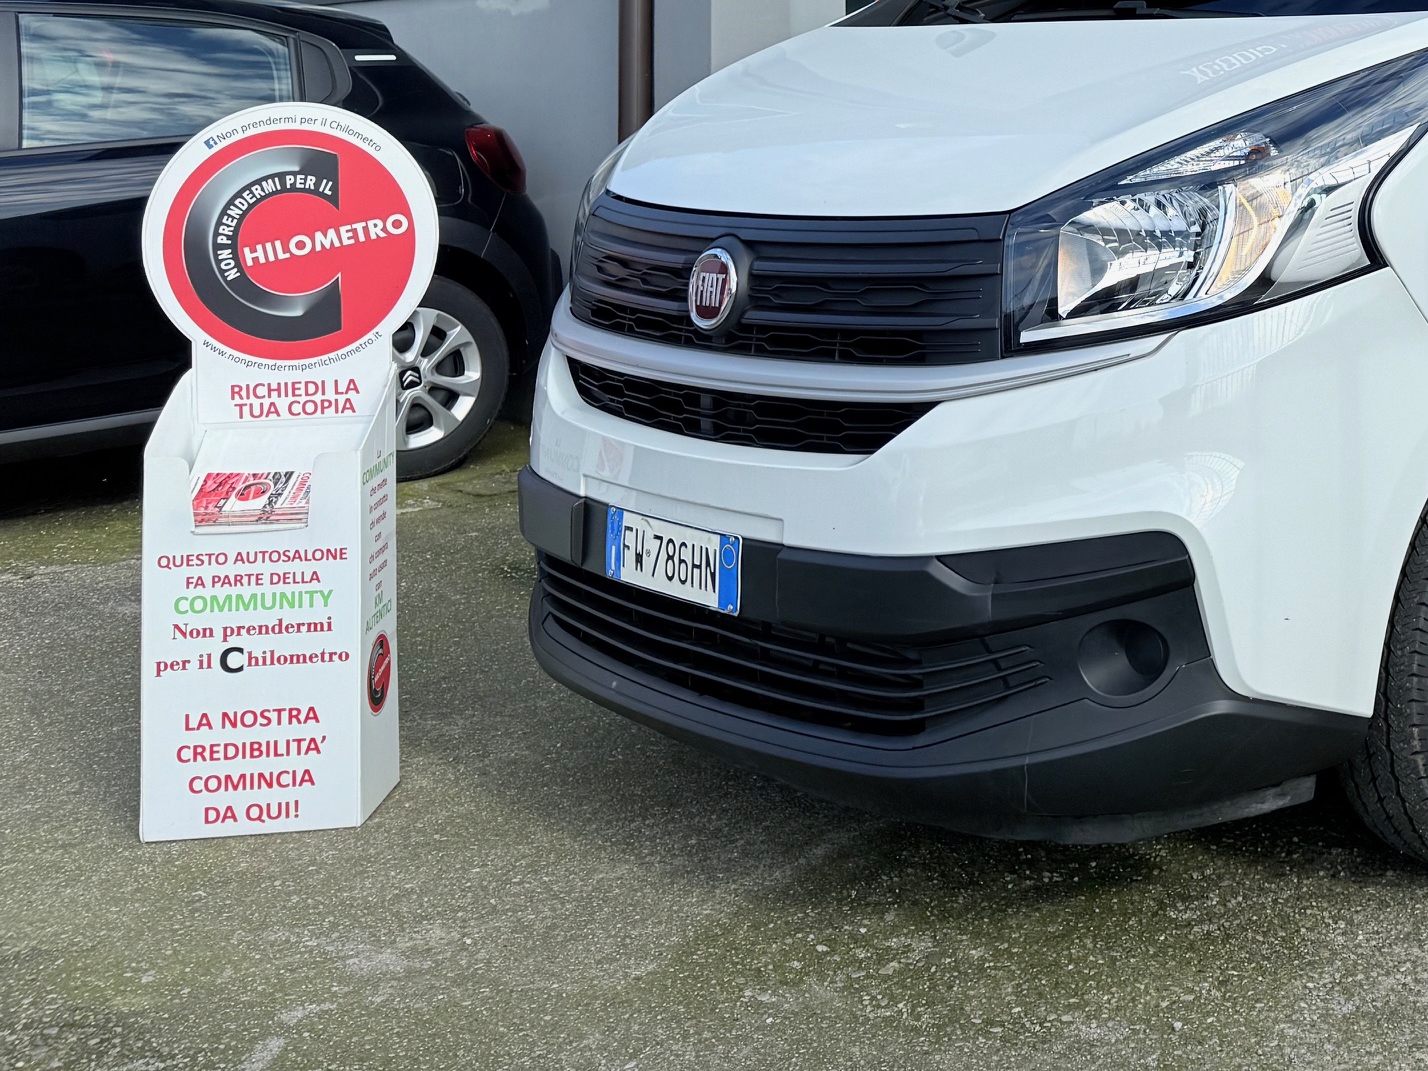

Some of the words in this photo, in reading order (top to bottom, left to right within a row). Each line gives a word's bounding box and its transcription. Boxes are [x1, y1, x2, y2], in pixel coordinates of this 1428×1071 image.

[216, 126, 239, 143] Non
[240, 115, 297, 135] prendermi
[299, 116, 318, 128] per
[320, 117, 327, 129] il
[329, 120, 382, 153] Chilometro
[286, 175, 317, 190] PER
[318, 178, 333, 196] IL
[217, 177, 281, 245] PRENDERMI
[217, 247, 241, 281] NON
[697, 271, 726, 308] FIAT
[202, 330, 383, 372] www.nonprendermiperilchilometro.it
[230, 380, 327, 401] RICHIEDI
[333, 378, 360, 396] LA
[234, 402, 281, 420] TUA
[287, 398, 356, 417] COPIA
[157, 551, 229, 570] QUESTO
[233, 546, 348, 565] AUTOSALONE
[185, 574, 207, 590] FA
[210, 572, 265, 588] PARTE
[269, 570, 321, 585] DELLA
[173, 589, 334, 616] COMMUNITY
[172, 622, 215, 641] Non
[221, 616, 334, 643] prendermi
[154, 656, 191, 678] per
[196, 652, 213, 671] il
[219, 646, 350, 674] Chilometro
[184, 712, 213, 732] LA
[221, 706, 321, 730] NOSTRA
[188, 768, 316, 795] COMINCIA
[203, 806, 238, 825] DA
[245, 800, 300, 823] QUI!
